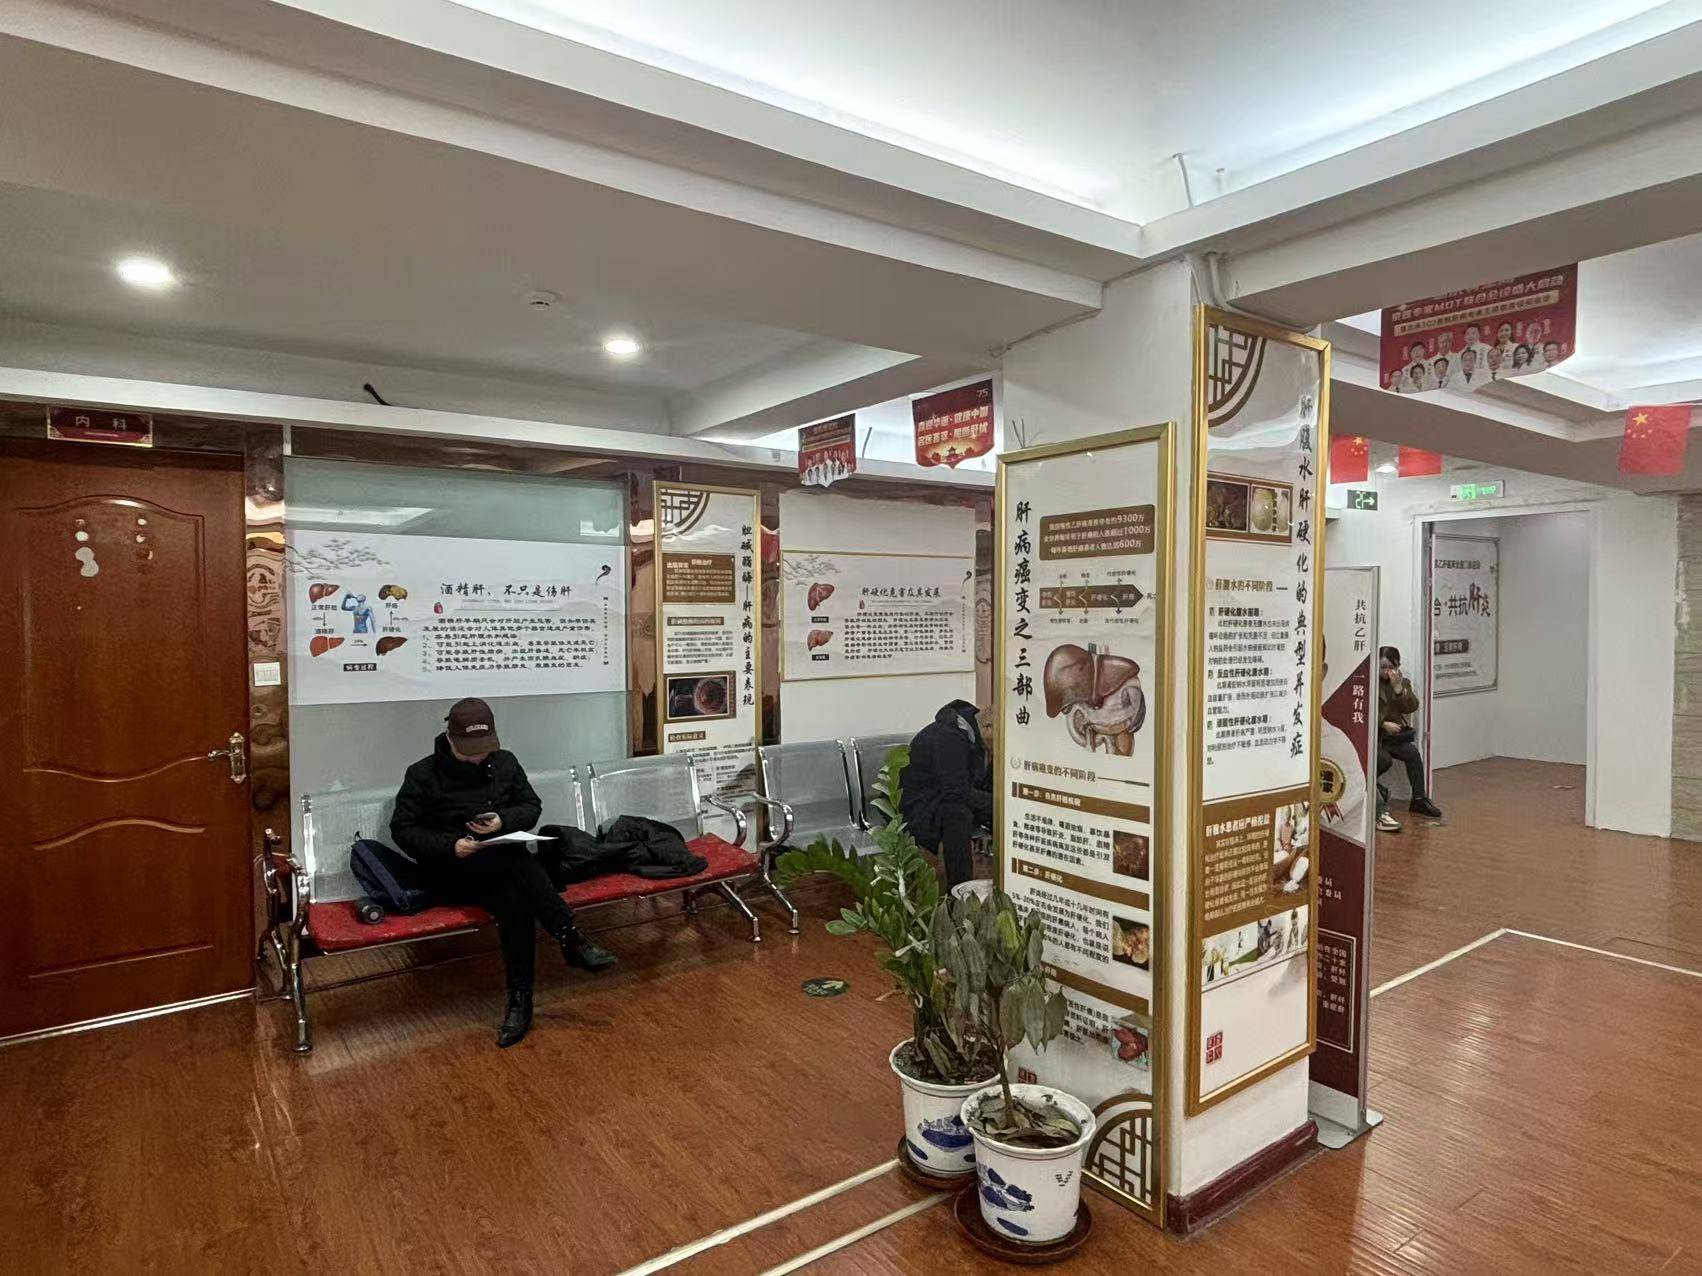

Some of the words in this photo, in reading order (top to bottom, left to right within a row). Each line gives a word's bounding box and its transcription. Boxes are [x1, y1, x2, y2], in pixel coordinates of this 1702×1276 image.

[440, 582, 572, 598] 酒精肝、不只是伤肝
[1216, 579, 1273, 592] 肝腹水的不同阶段
[1291, 394, 1313, 758] 肝腹水肝硬化的典型并发症
[1013, 501, 1033, 726] 肝病癌变之三部曲
[1354, 599, 1366, 652] 共抗乙肝
[1352, 673, 1365, 724] 一路有我
[1024, 760, 1096, 782] 肝病癌变的不同阶段
